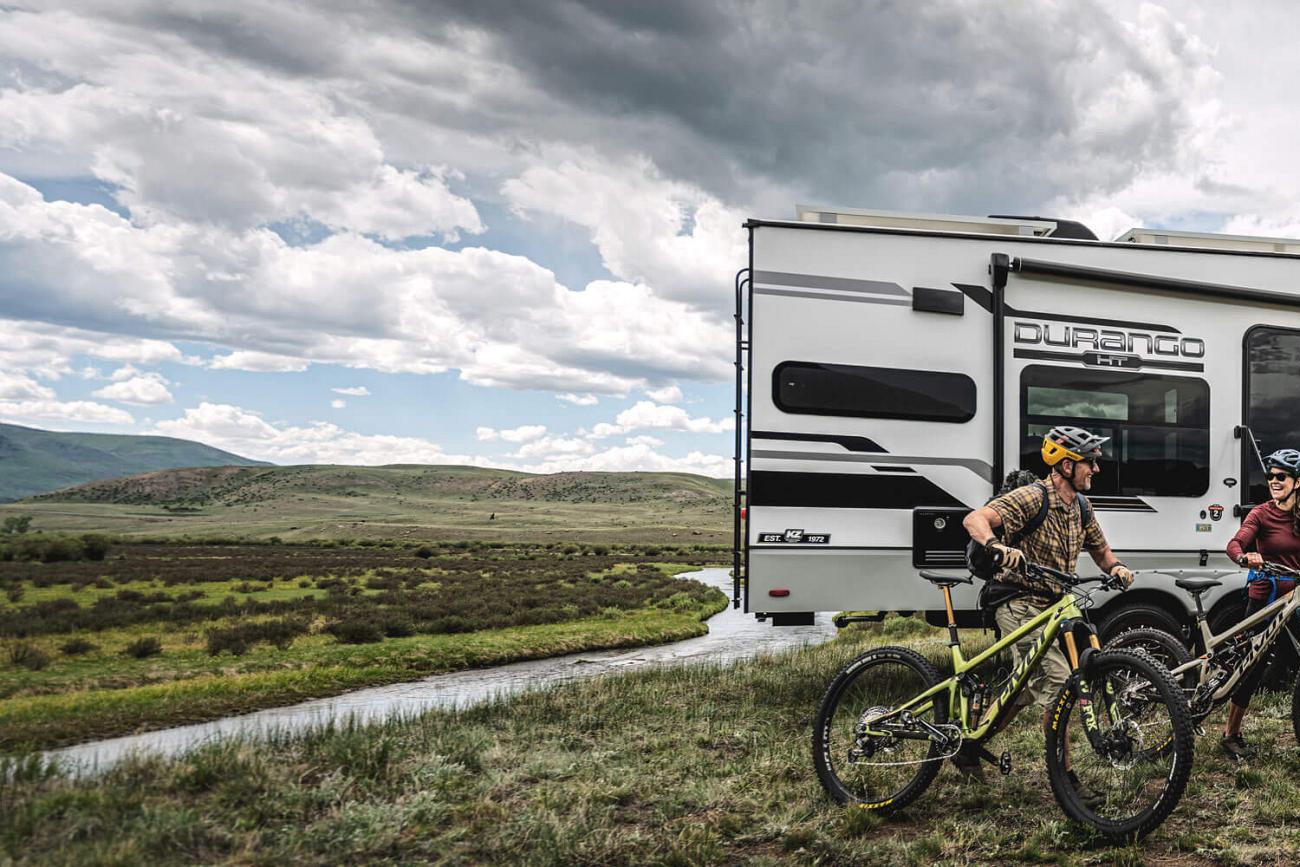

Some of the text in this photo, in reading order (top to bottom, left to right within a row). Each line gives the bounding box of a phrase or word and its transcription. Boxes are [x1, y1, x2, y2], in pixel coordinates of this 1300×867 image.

[1097, 354, 1128, 367] HT
[786, 530, 802, 539] KZ
[1052, 689, 1071, 731] MAXXIS
